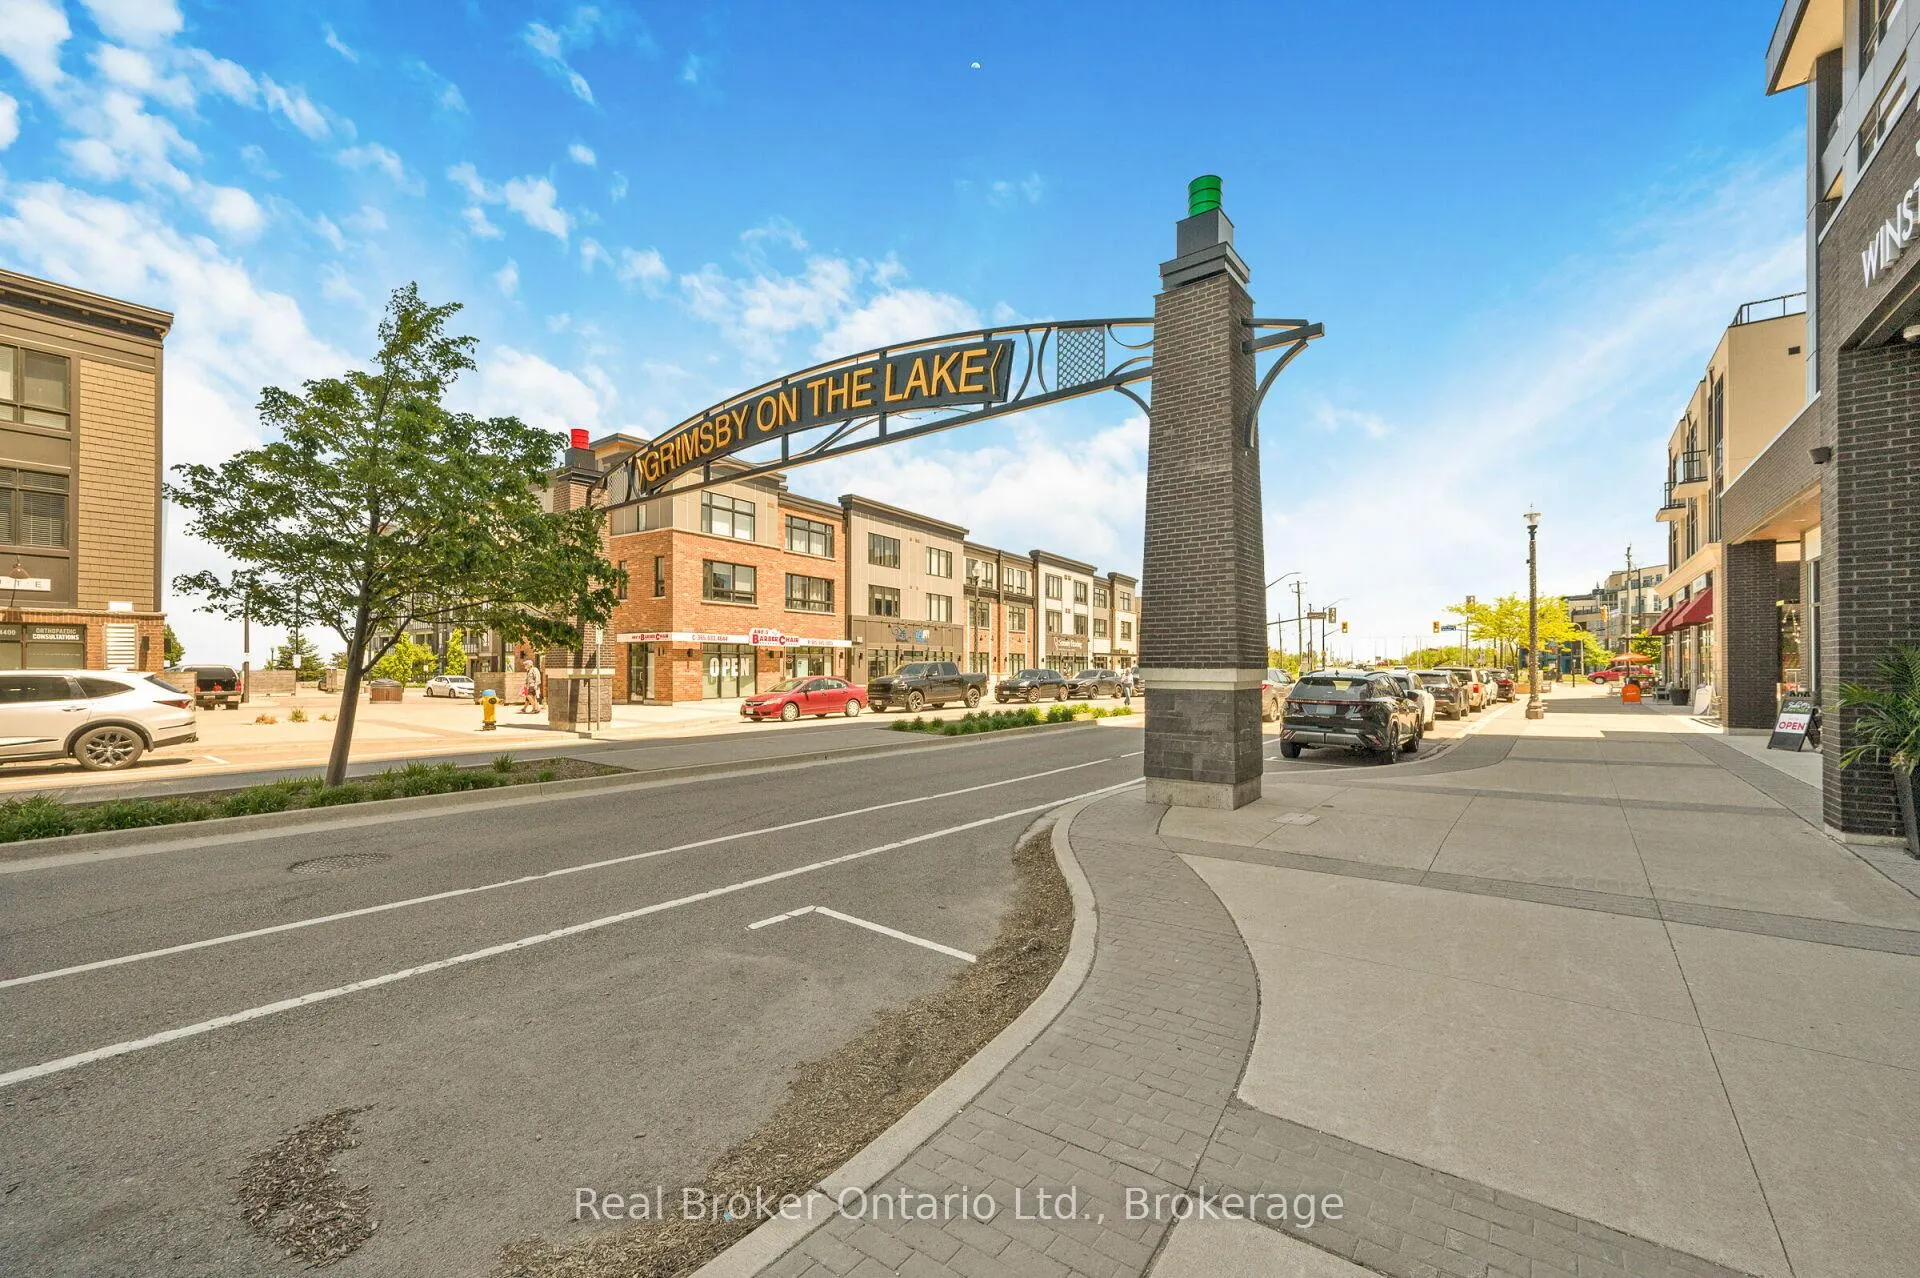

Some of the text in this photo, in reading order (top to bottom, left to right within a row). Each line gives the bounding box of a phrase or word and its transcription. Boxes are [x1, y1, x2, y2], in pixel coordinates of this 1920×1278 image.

[644, 348, 988, 482] GRIMSBY ON THE LAKE
[35, 627, 77, 635] ORTHOPAEDIC
[32, 633, 80, 641] CONSULTATIONS
[709, 657, 750, 678] OPEN
[1778, 721, 1806, 731] OPEN
